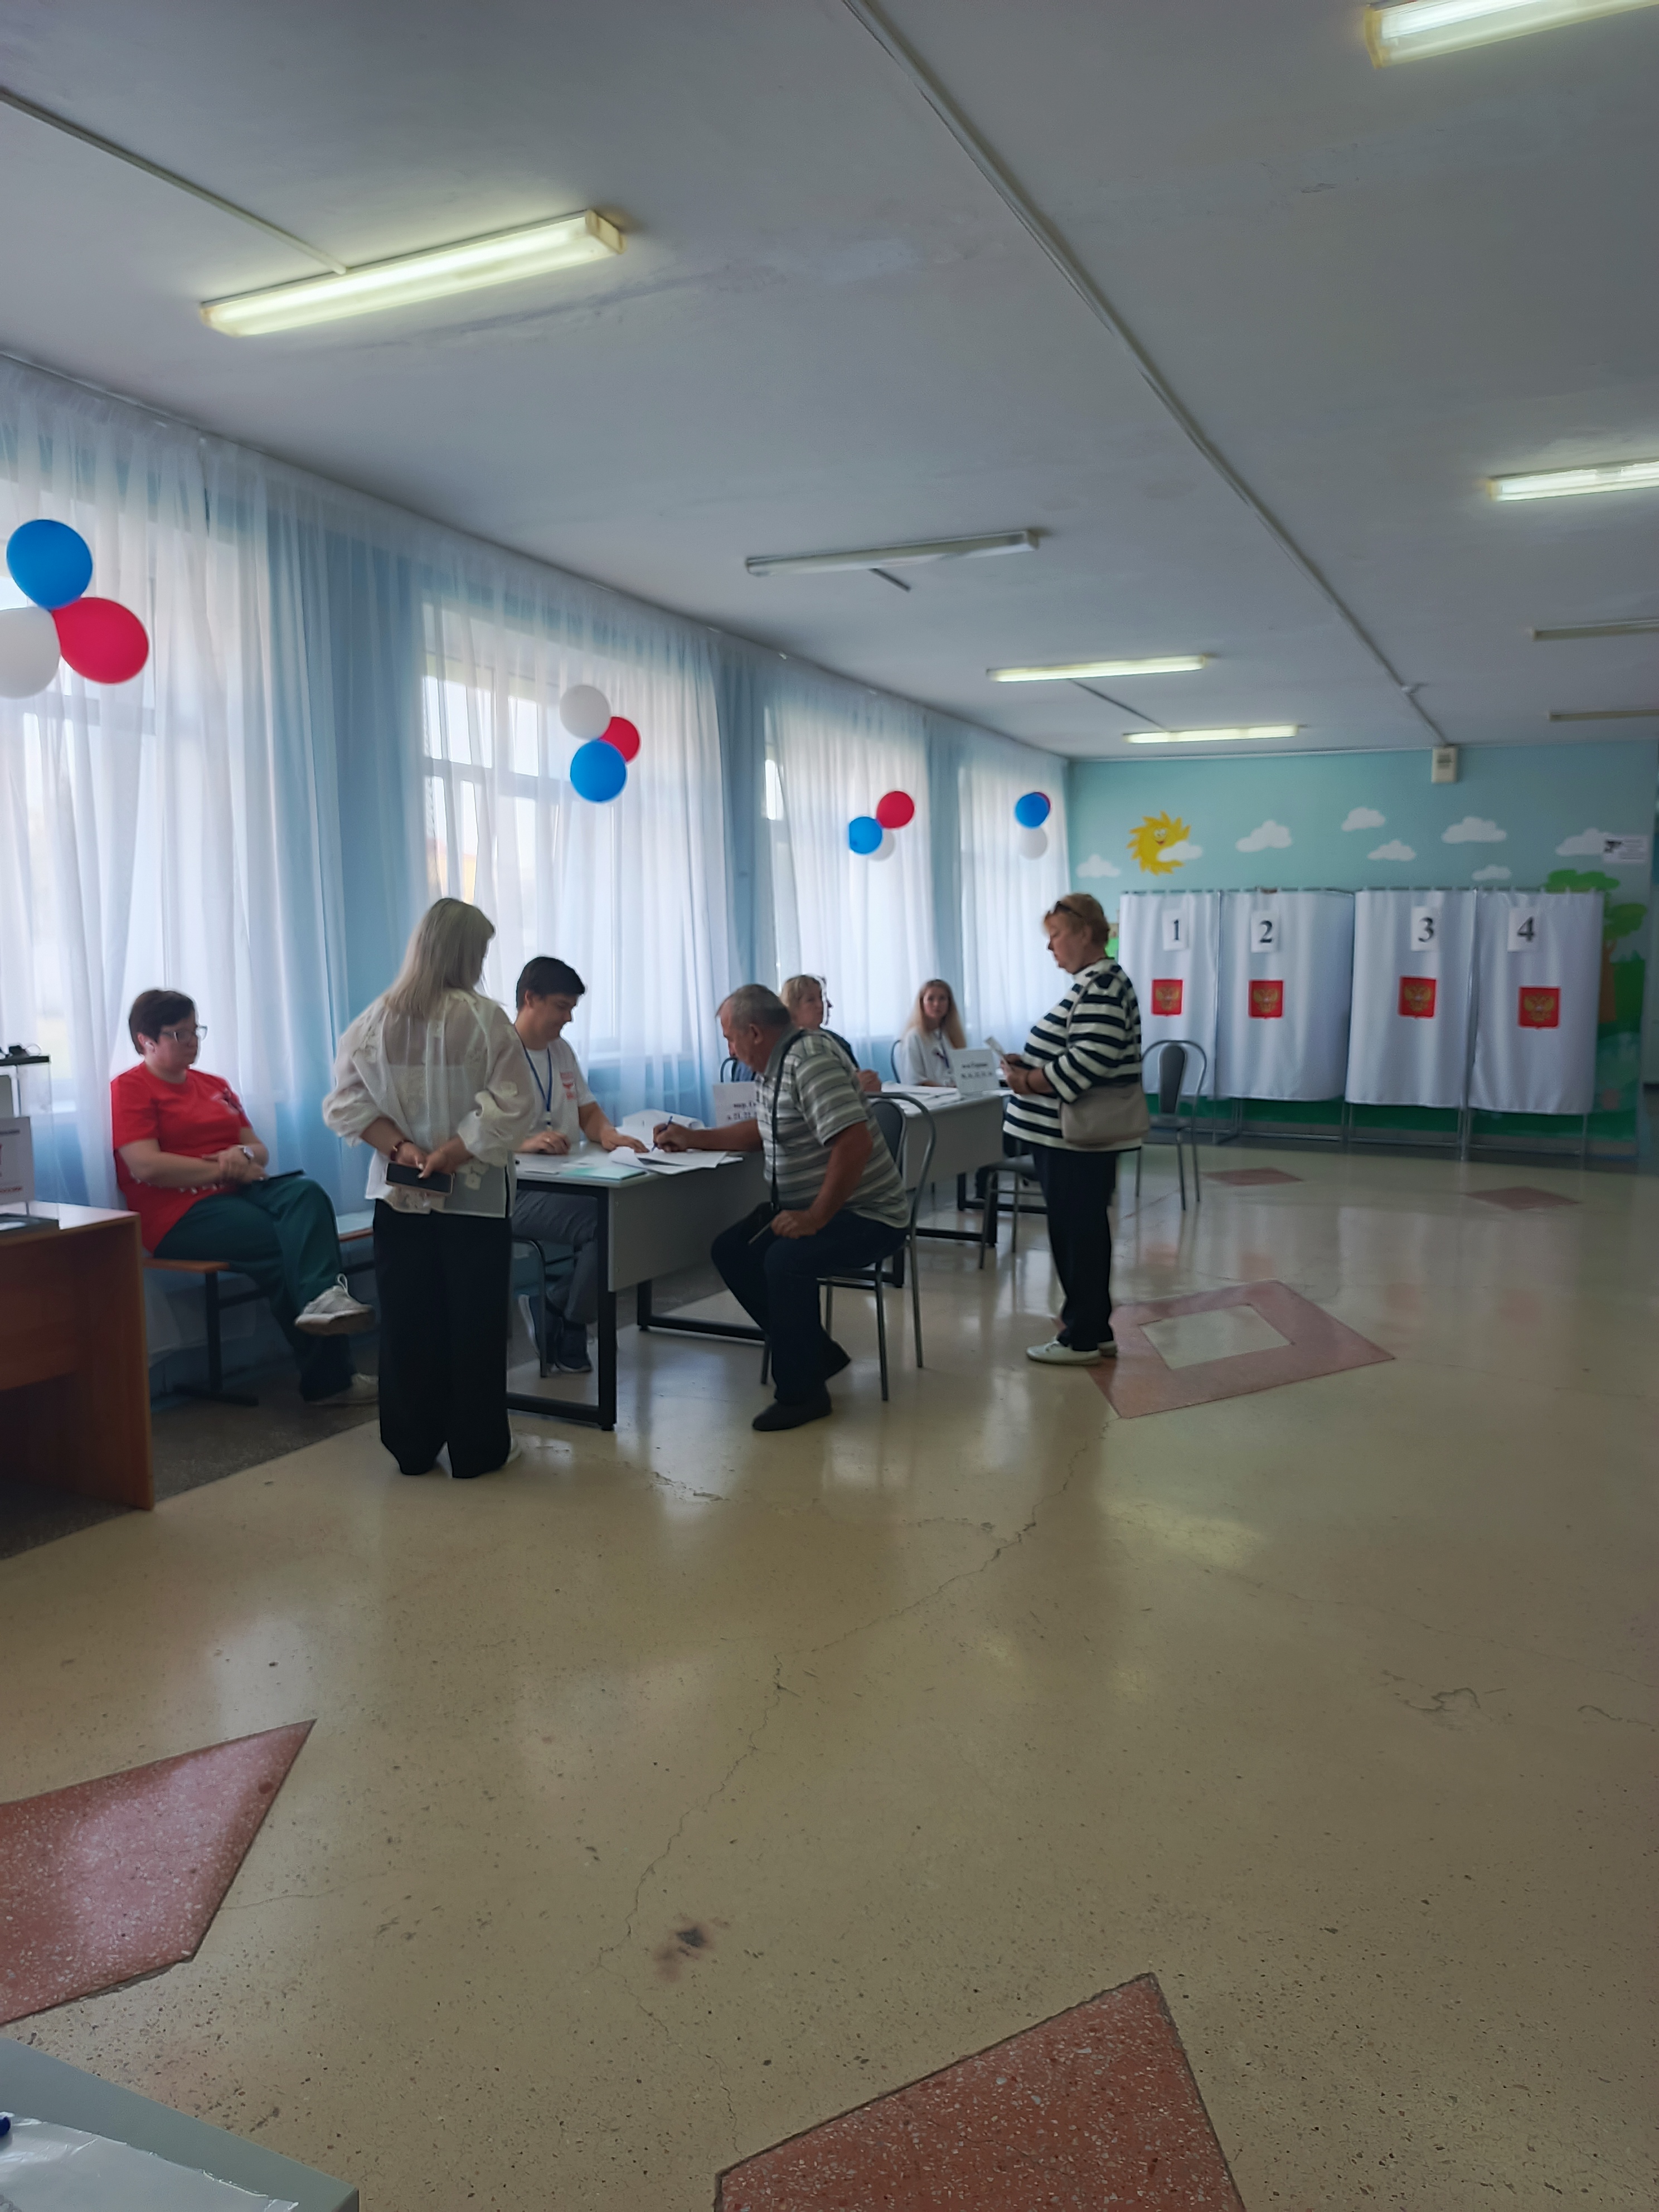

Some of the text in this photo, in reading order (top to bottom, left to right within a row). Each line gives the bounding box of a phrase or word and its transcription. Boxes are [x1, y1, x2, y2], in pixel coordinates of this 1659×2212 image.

[1173, 919, 1180, 940] 1
[1259, 920, 1273, 943] 2
[1418, 917, 1434, 943] 3
[1516, 916, 1534, 942] 4
